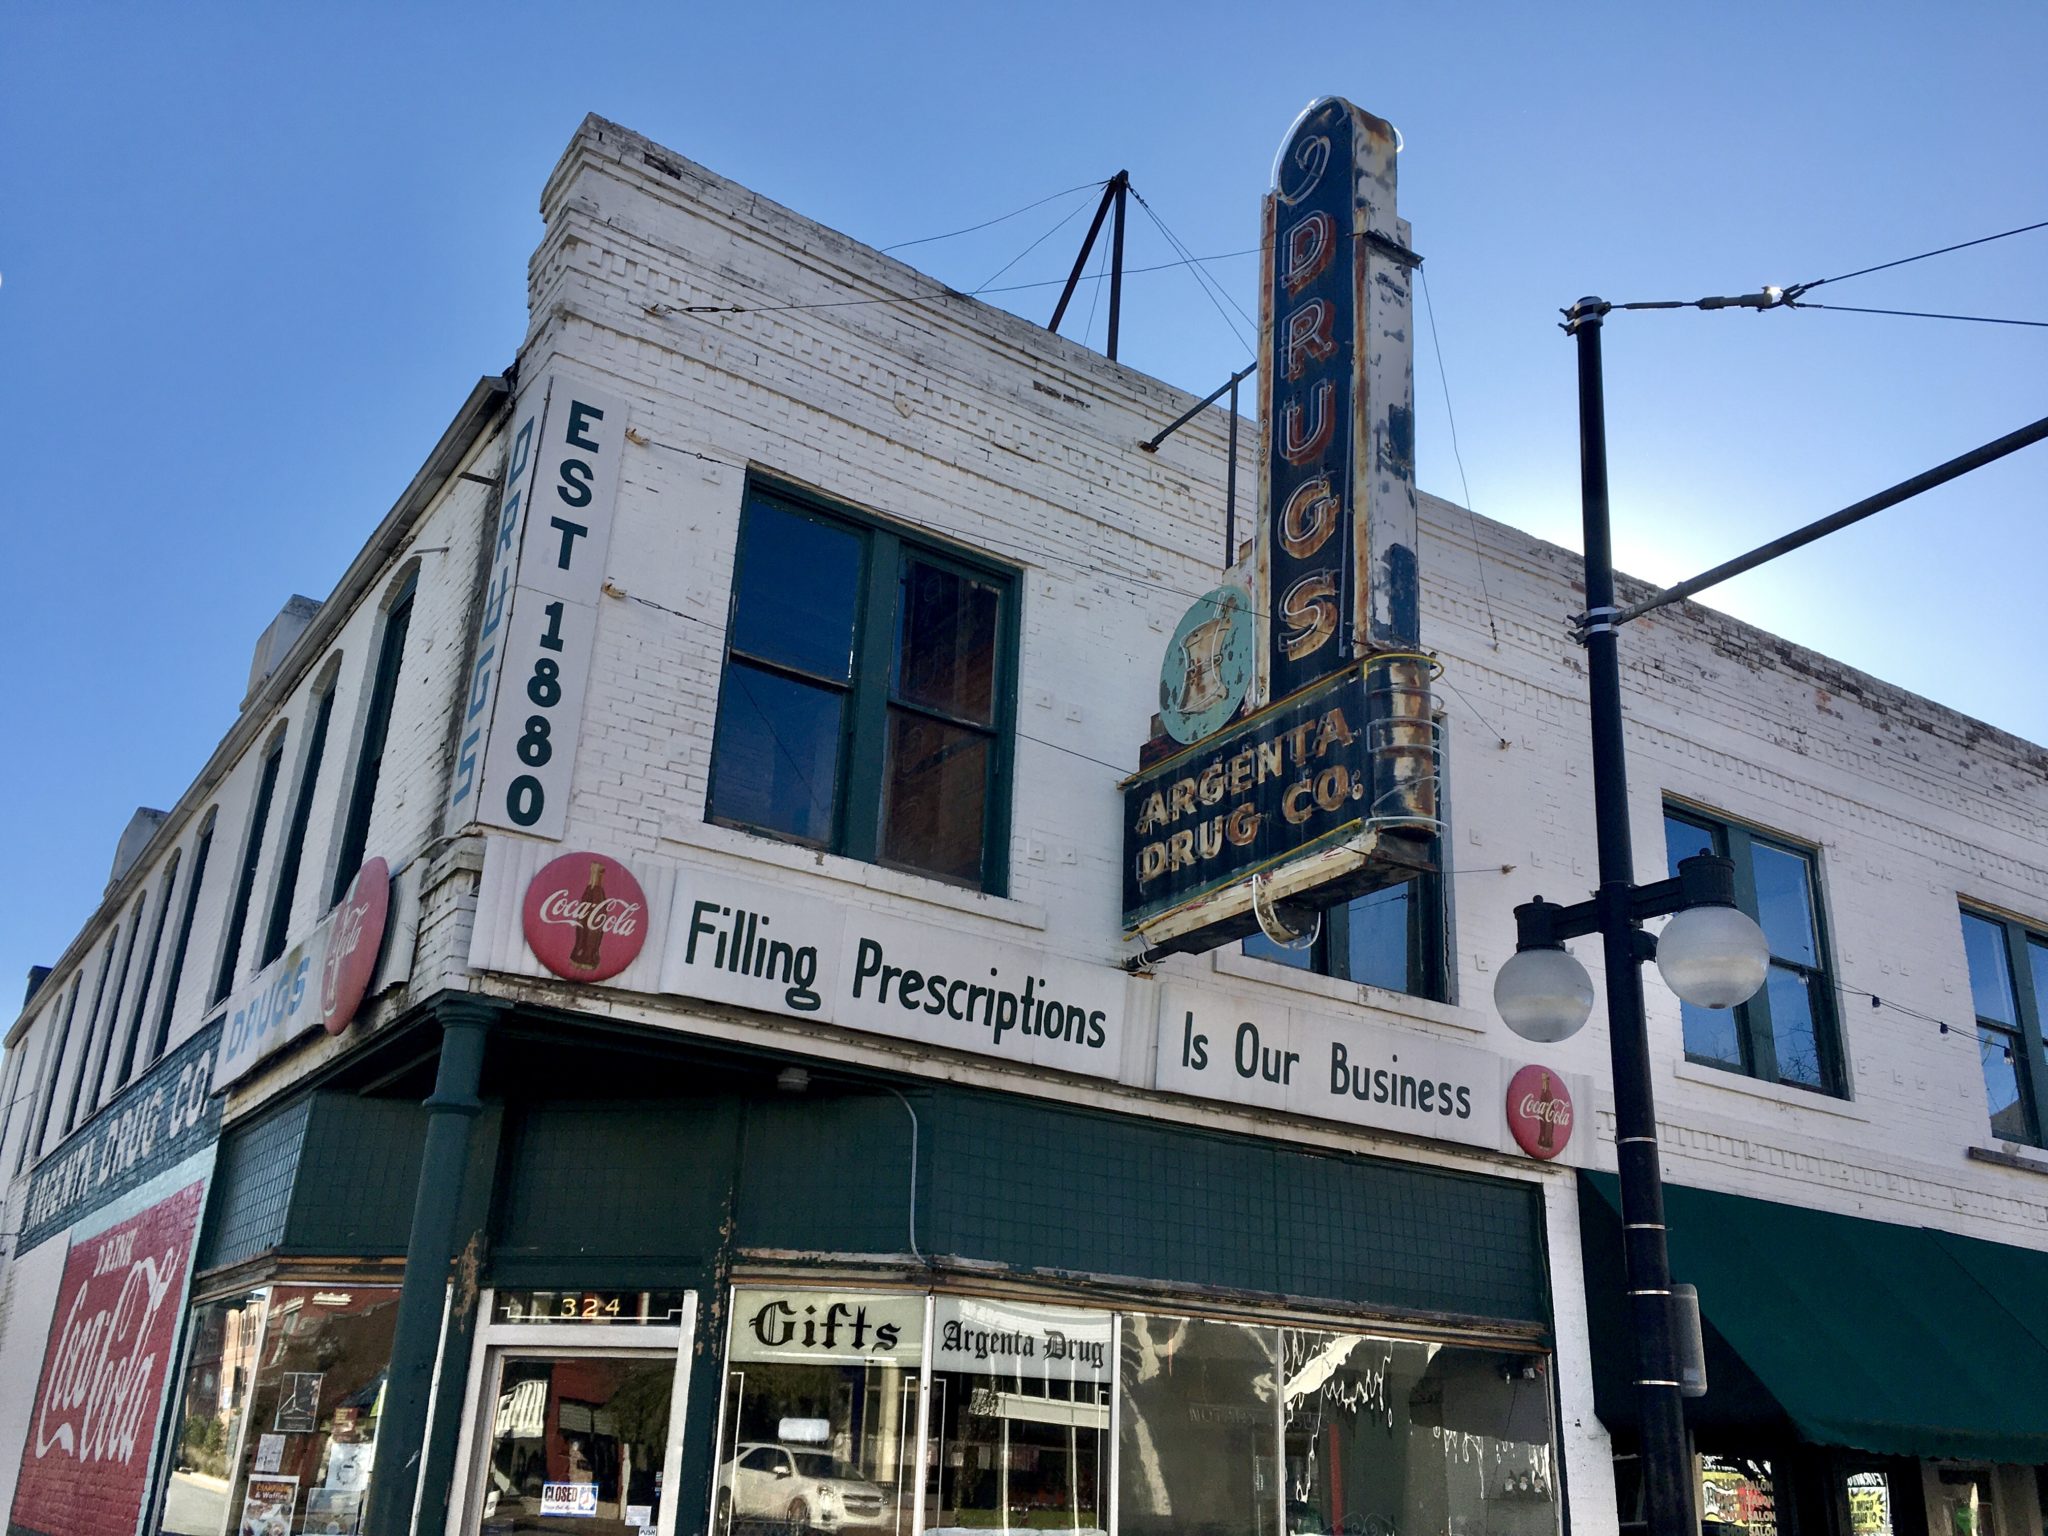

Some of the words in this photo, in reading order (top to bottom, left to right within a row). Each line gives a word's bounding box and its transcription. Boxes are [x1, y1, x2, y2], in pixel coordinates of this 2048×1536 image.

[1277, 210, 1341, 662] DRUGS
[550, 399, 604, 570] EST
[453, 415, 535, 807] DRUGS
[506, 600, 564, 827] 1880
[1135, 707, 1355, 834] ARGENTA
[1136, 803, 1262, 884] DRUG
[539, 888, 642, 937] Coca-Cola
[226, 956, 311, 1063] DRUGS
[685, 900, 822, 1012] Filling
[852, 937, 1107, 1049] Prescriptions
[1182, 1010, 1208, 1070] Is
[1234, 1021, 1300, 1086] Our
[1330, 1041, 1471, 1120] Business
[1518, 1092, 1570, 1127] Coca-Cola
[22, 1137, 97, 1237] ARGENTA
[98, 1087, 163, 1186] DRUG
[93, 1228, 138, 1278] DRINK
[561, 1298, 620, 1317] 324
[749, 1300, 901, 1352] Gifts
[941, 1320, 1035, 1360] Argenta
[1043, 1328, 1104, 1369] Drug
[544, 1485, 577, 1503] CLOSED
